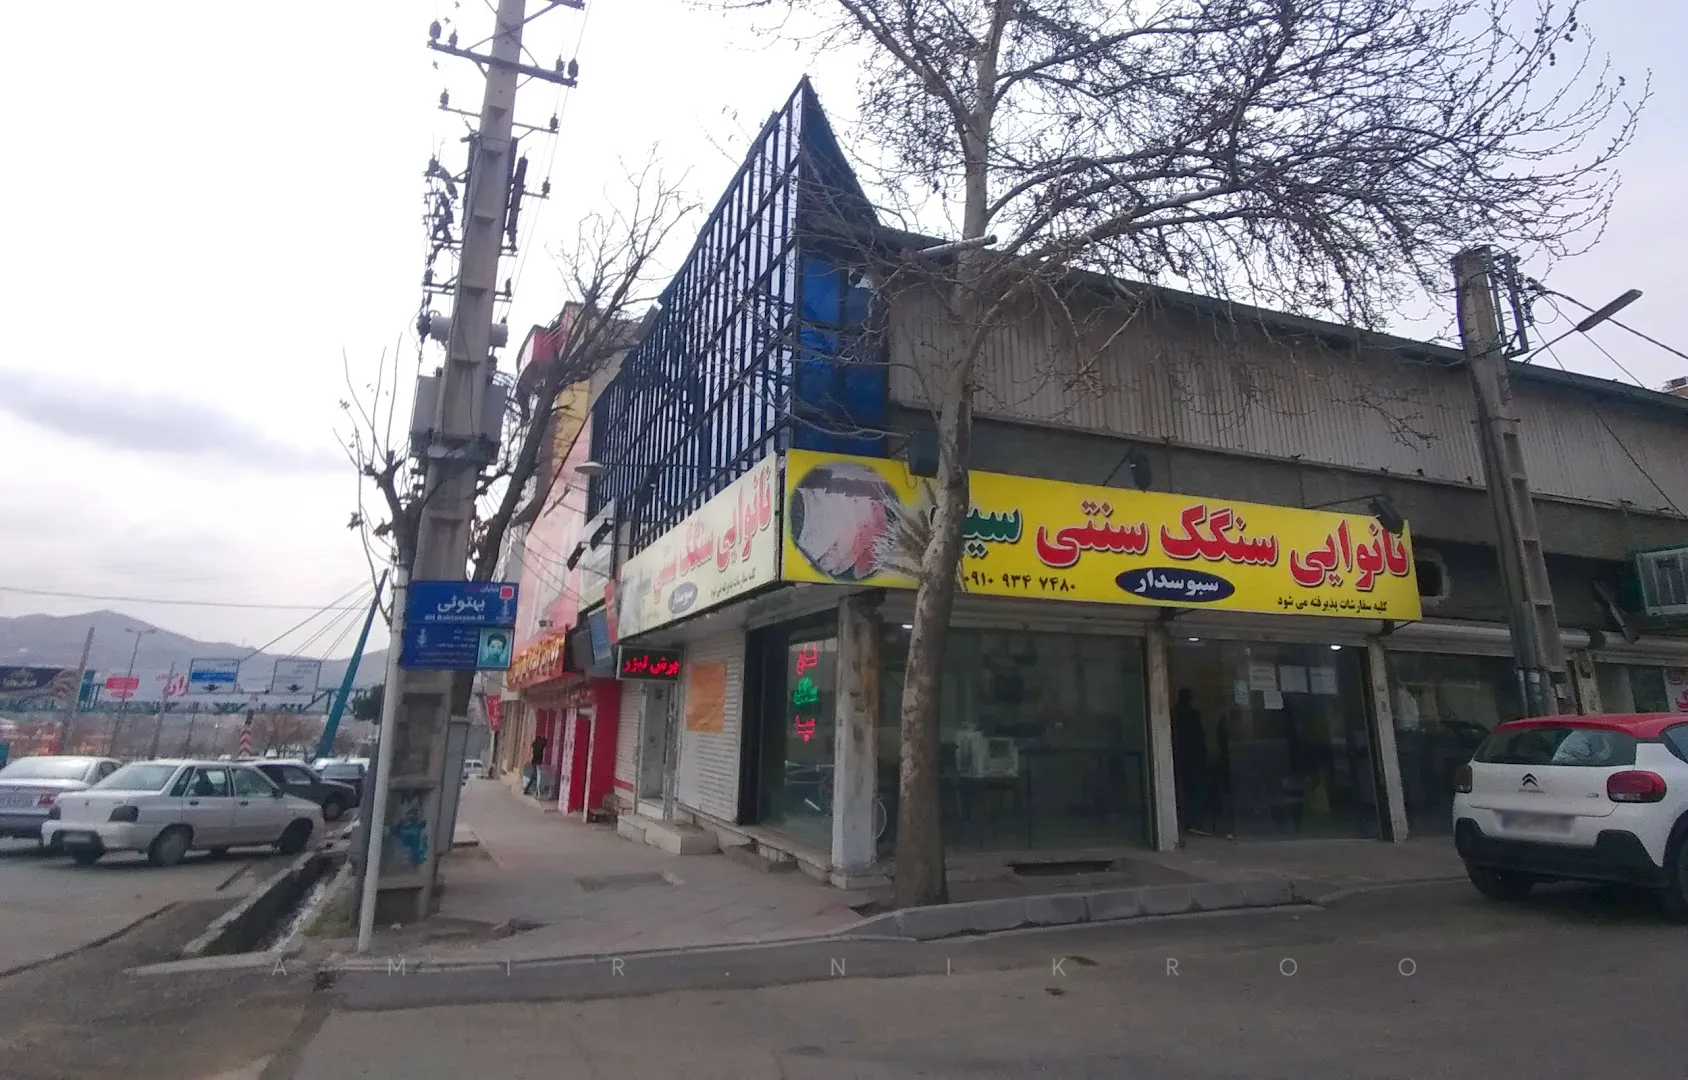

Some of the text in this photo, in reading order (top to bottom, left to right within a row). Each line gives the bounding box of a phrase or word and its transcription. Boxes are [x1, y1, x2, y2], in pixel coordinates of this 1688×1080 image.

[1036, 500, 1149, 568] سنتی
[1160, 504, 1279, 566] سنگک
[1289, 518, 1410, 592] نانوایی
[1135, 568, 1219, 596] سبوسدار
